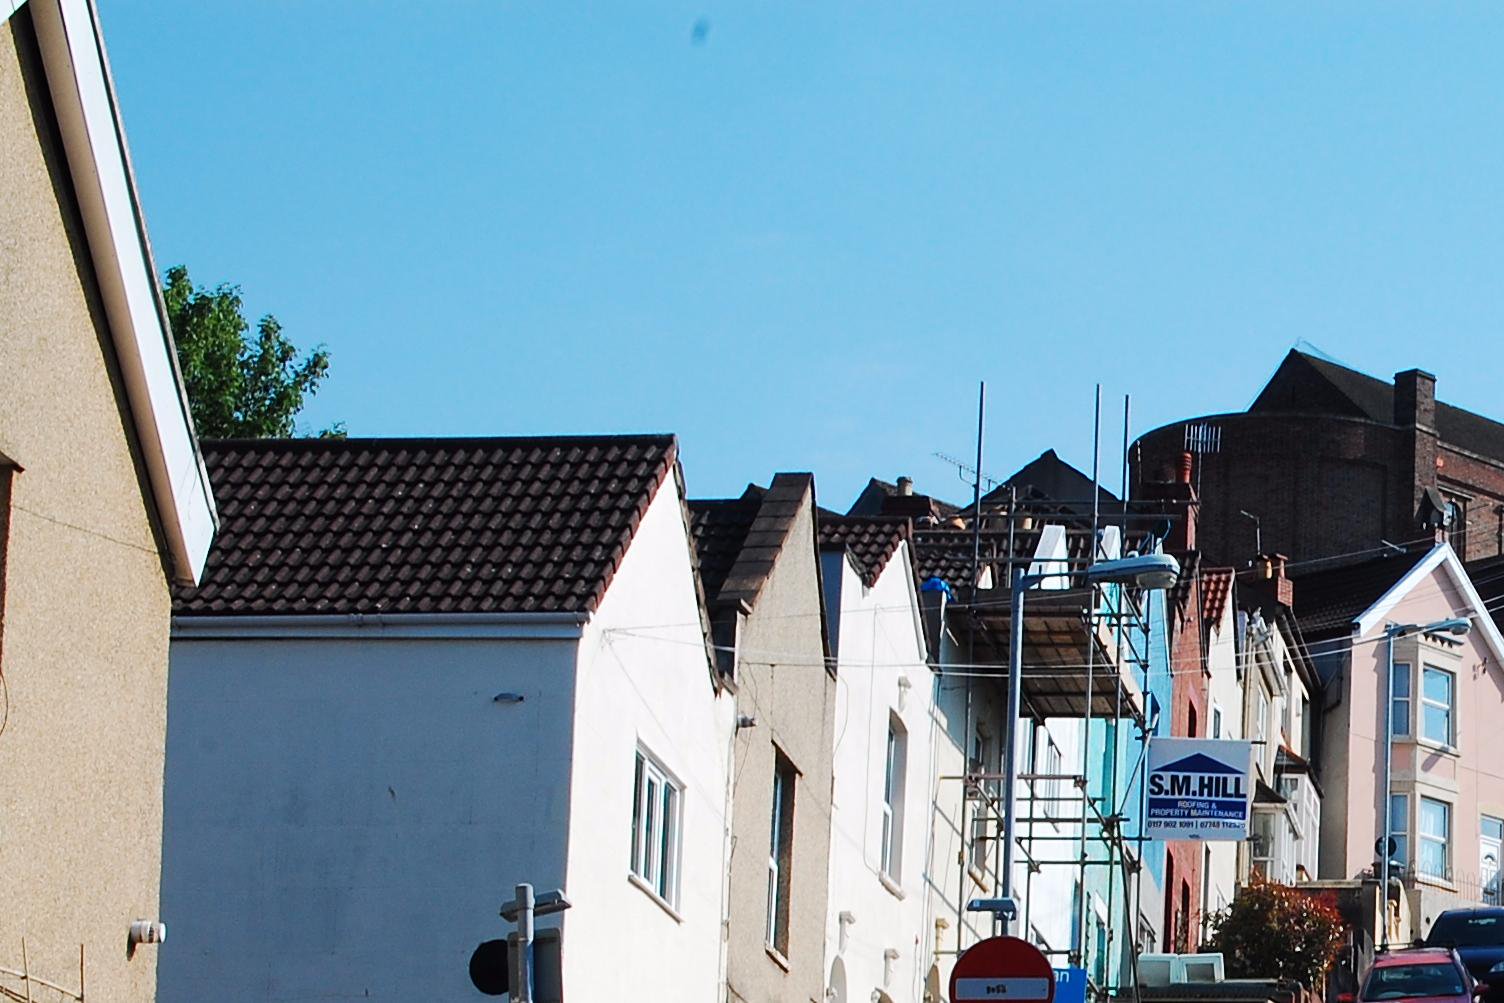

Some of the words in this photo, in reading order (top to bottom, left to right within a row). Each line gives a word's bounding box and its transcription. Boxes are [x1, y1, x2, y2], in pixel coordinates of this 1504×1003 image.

[1149, 774, 1247, 798] S.M.HILL
[1177, 801, 1209, 809] ROOFING
[1150, 808, 1188, 816] PROPERTY
[1190, 809, 1244, 819] MAINTENANCE
[1147, 820, 1163, 829] 0117
